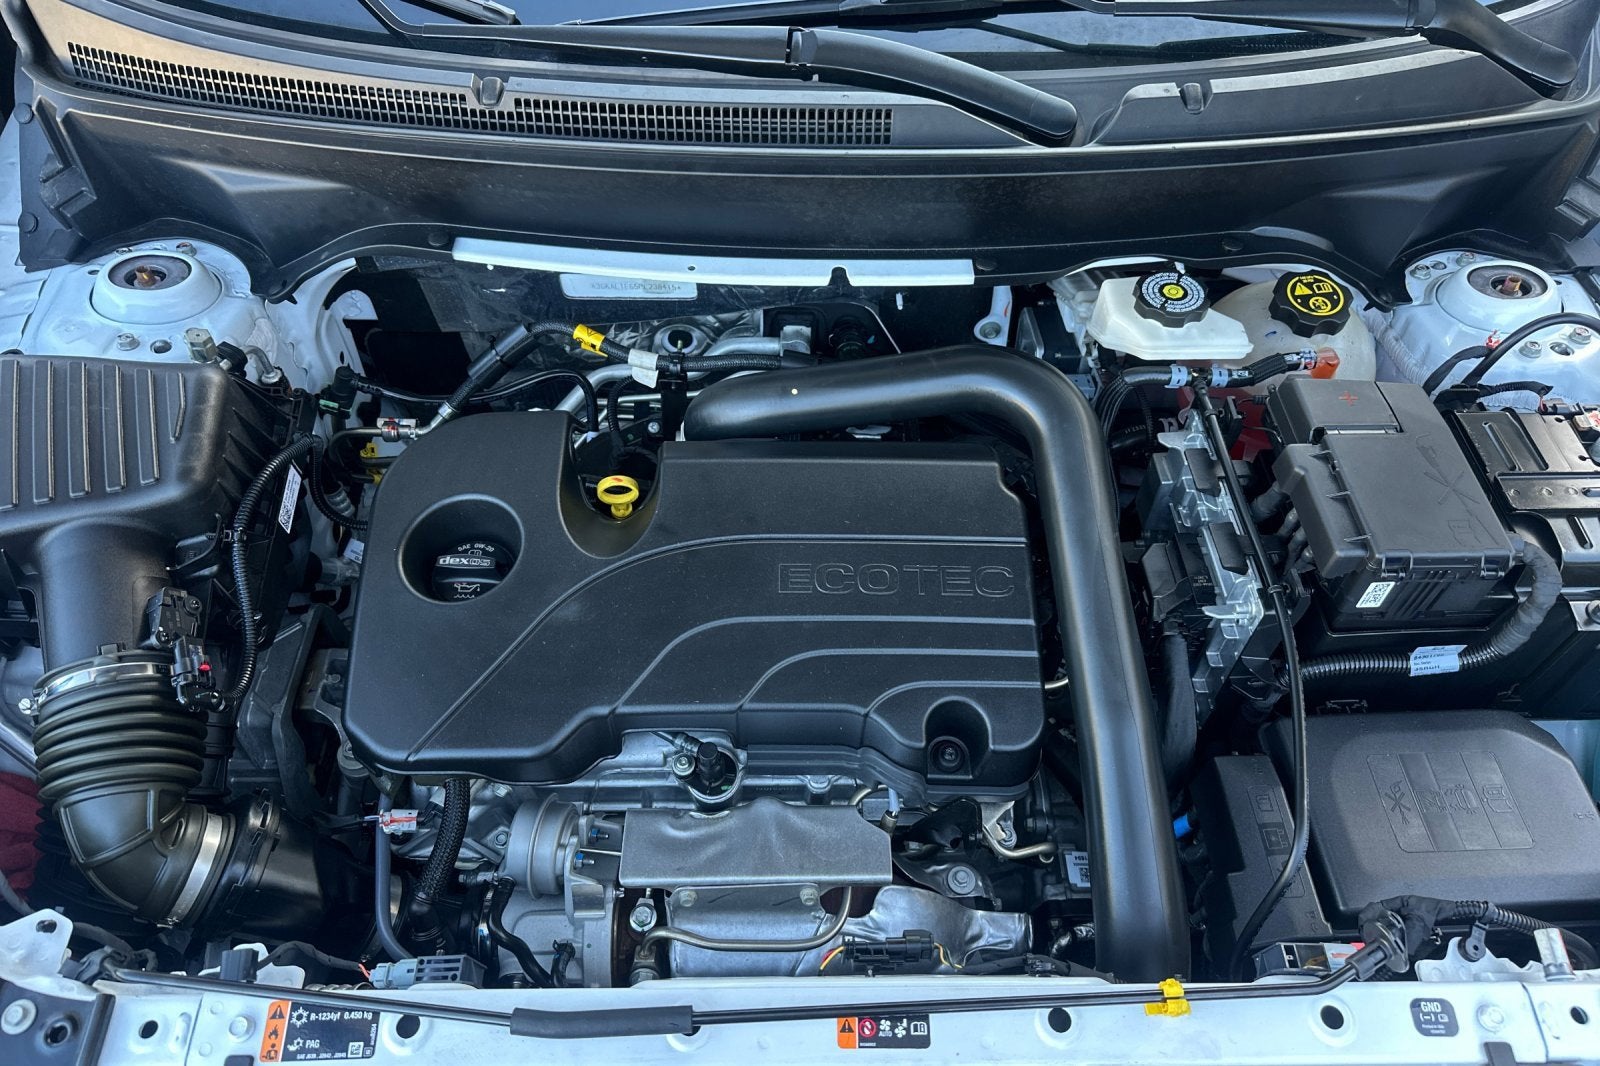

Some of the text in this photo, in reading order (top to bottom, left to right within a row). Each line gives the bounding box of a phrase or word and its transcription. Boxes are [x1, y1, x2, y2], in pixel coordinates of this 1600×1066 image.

[778, 563, 1015, 597] ECOTEC
[1420, 1001, 1442, 1013] GND
[310, 1011, 373, 1021] R-1234yf 0.450 kg
[305, 1039, 320, 1048] PAG
